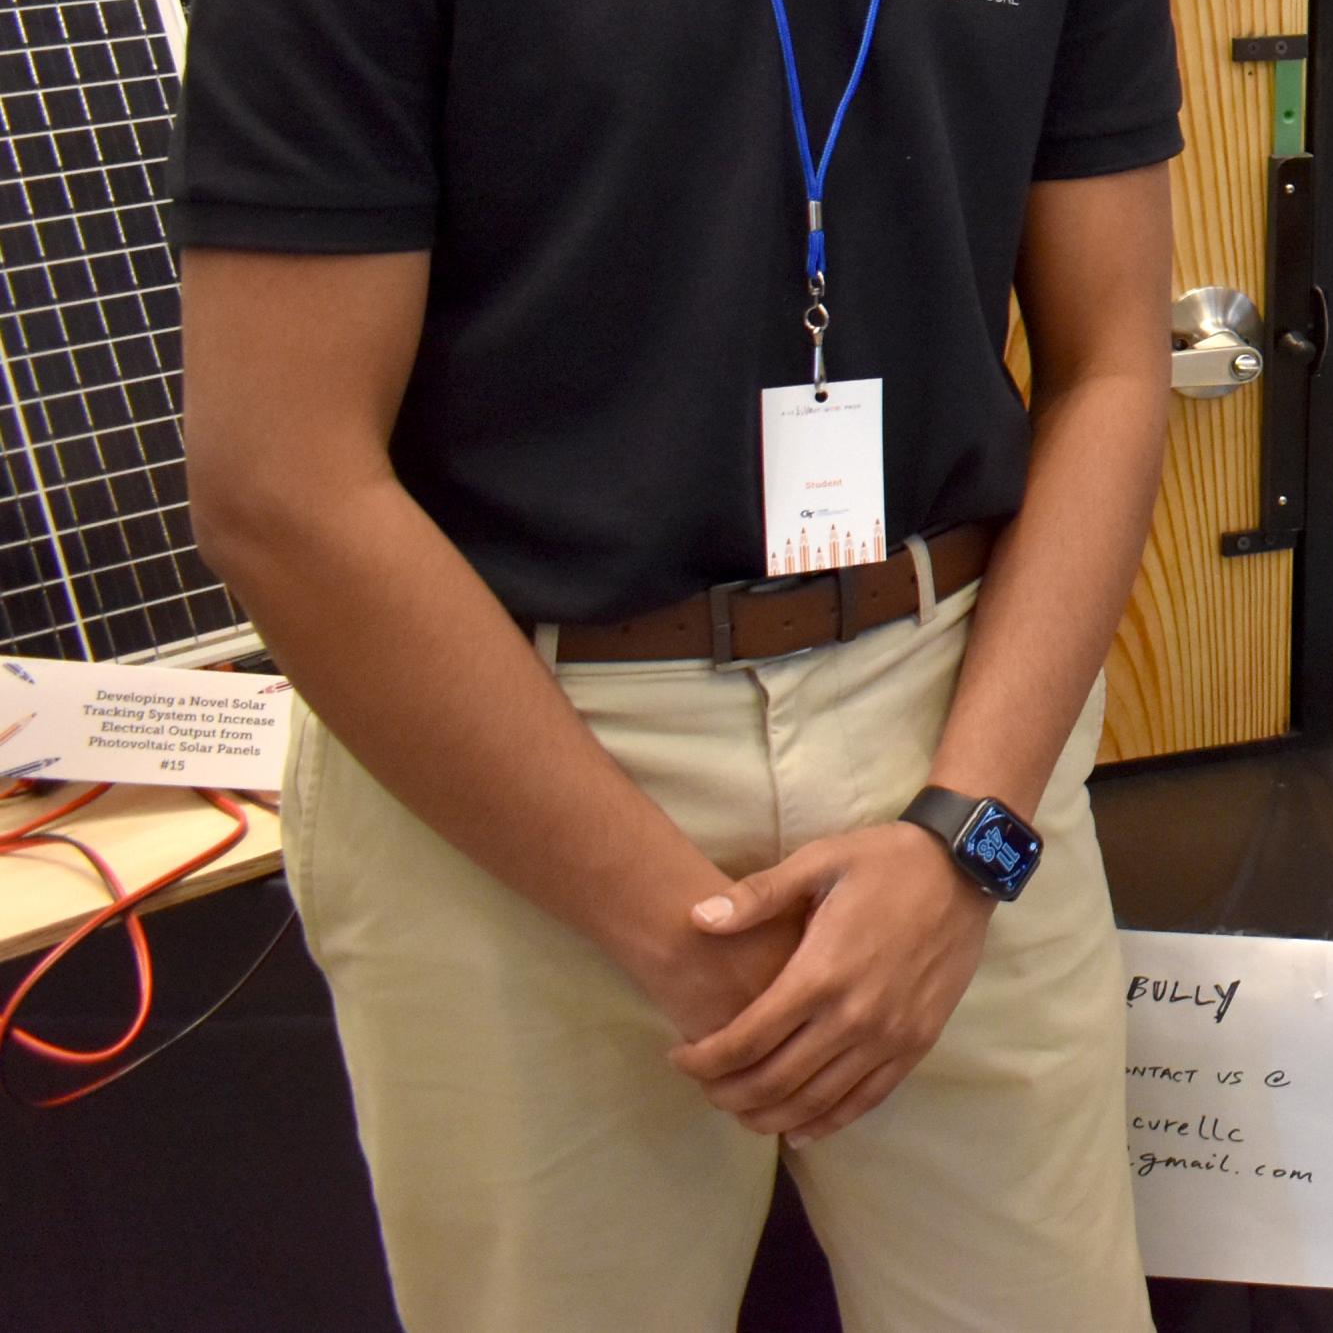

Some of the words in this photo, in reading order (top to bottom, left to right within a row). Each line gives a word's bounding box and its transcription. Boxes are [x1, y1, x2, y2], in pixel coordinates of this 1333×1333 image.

[97, 690, 175, 707] Developing
[178, 697, 186, 706] a
[190, 696, 229, 709] Novel
[232, 699, 267, 711] Solar
[83, 706, 145, 722] Tracking
[149, 710, 197, 724] System
[202, 713, 214, 723] to
[218, 715, 275, 727] Increase
[101, 722, 165, 736] Electrical
[169, 726, 217, 740] Output
[221, 728, 253, 741] from
[89, 737, 176, 752] Photovoltaic
[179, 742, 213, 755] Solar
[217, 746, 262, 757] Panels
[160, 760, 186, 771] #15
[1127, 975, 1241, 1024] BULLY
